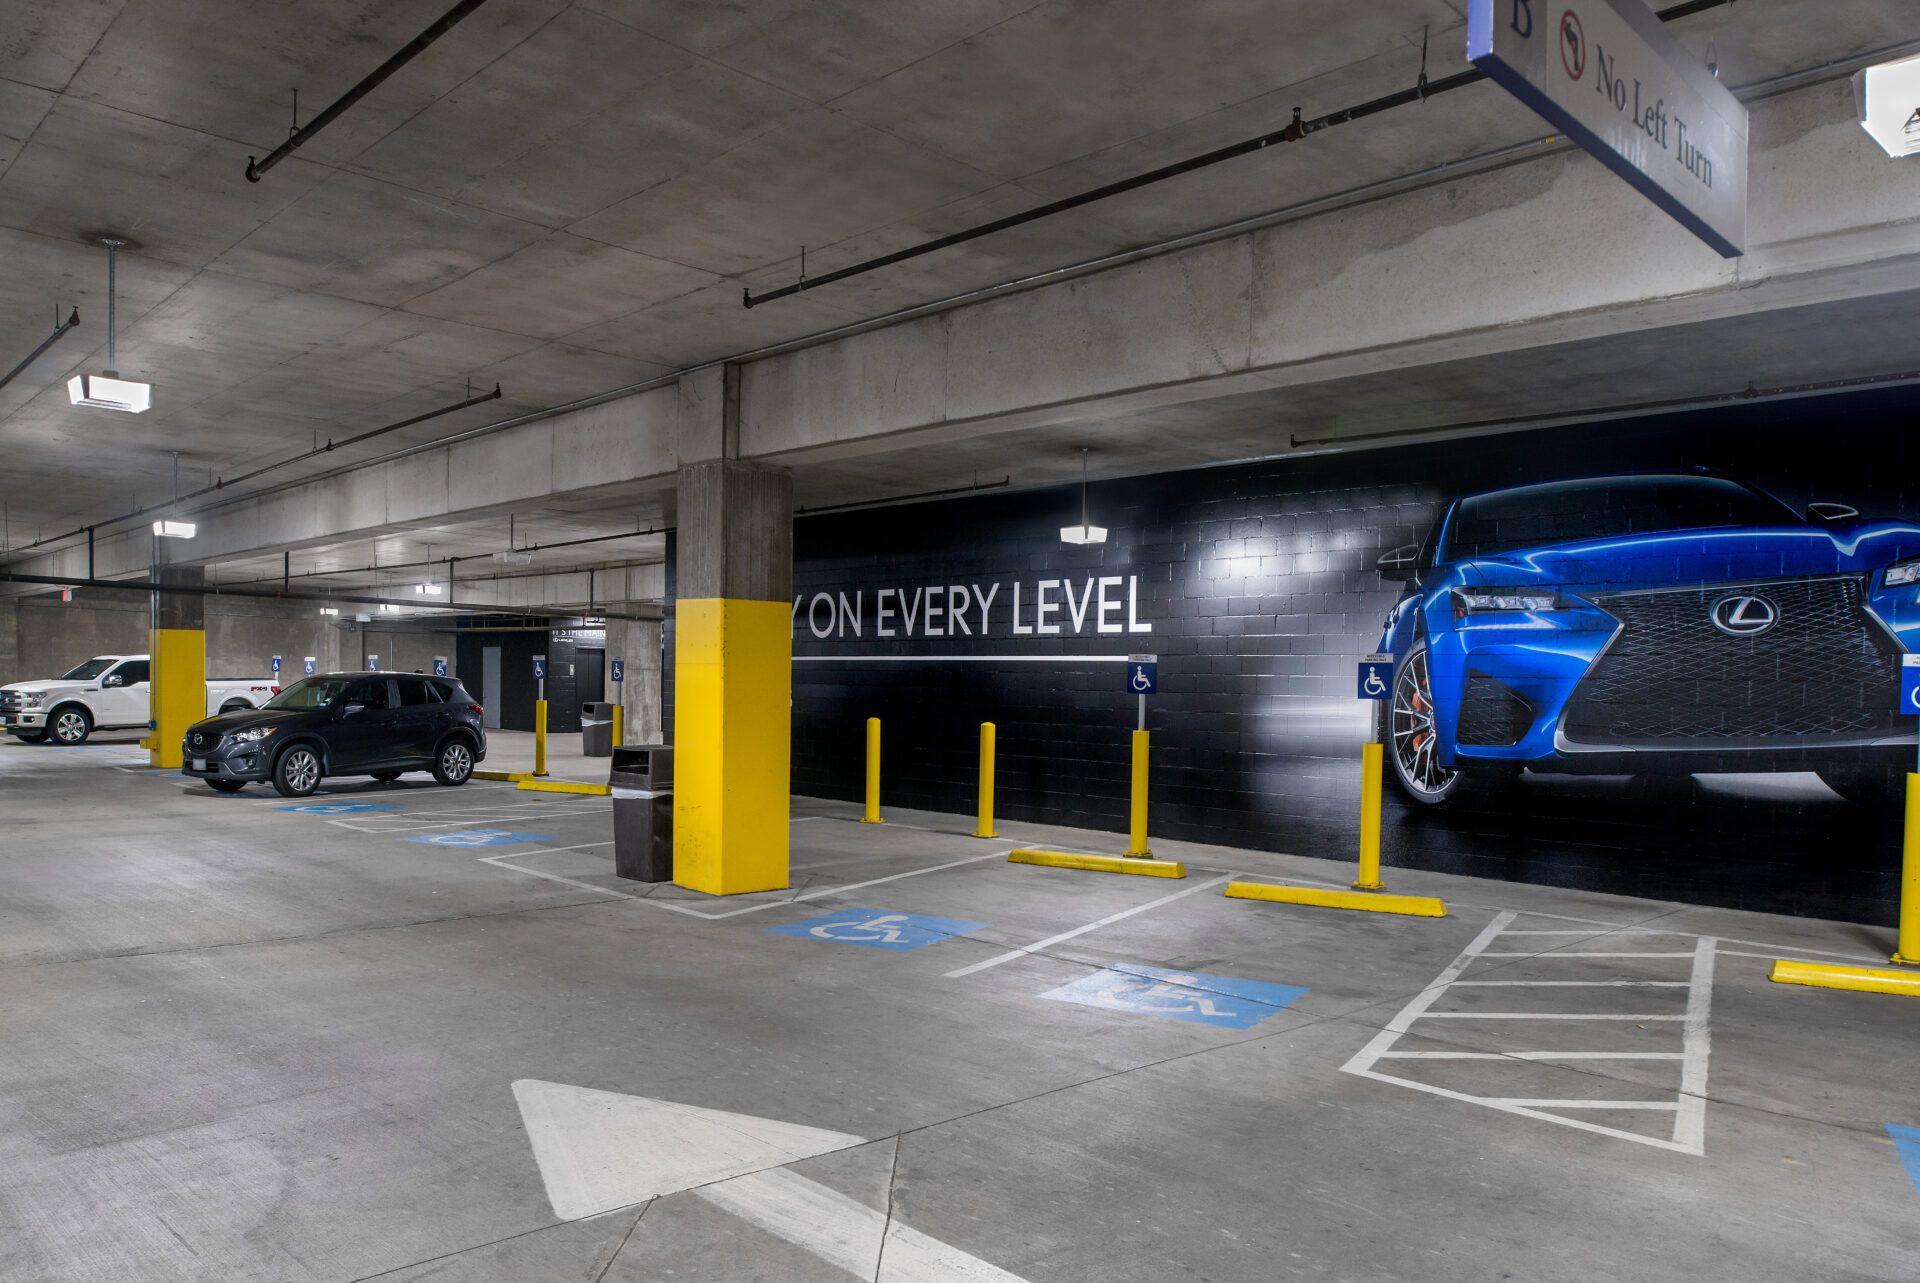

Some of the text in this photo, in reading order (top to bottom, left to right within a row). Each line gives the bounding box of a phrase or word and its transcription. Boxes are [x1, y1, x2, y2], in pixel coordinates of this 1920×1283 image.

[1596, 43, 1712, 189] No Left Turn
[809, 592, 862, 638] ON
[877, 583, 1000, 637] EVERY
[1013, 575, 1152, 635] LEVEL
